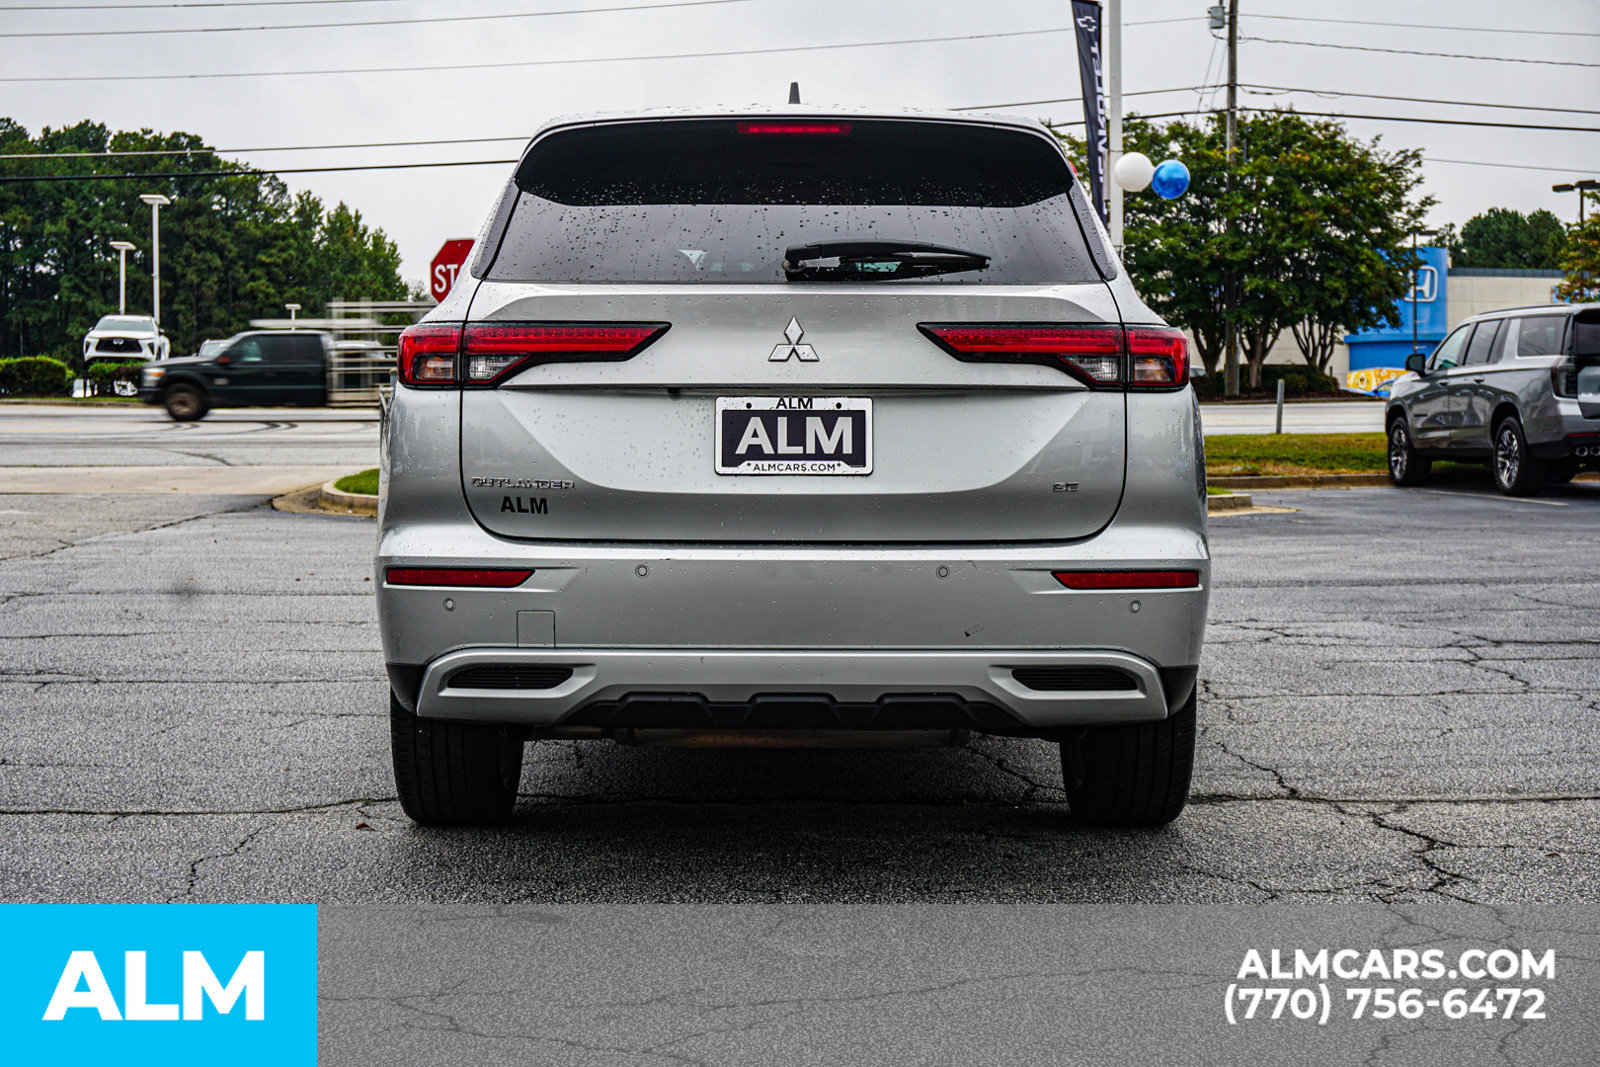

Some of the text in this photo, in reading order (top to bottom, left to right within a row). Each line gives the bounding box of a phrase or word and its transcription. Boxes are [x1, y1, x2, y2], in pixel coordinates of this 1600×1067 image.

[434, 264, 459, 293] ST
[775, 397, 814, 410] ALM
[735, 416, 853, 455] ALM
[753, 463, 836, 472] ALMCARS.COM
[471, 476, 575, 490] OUTLANDER
[500, 496, 549, 515] ALM
